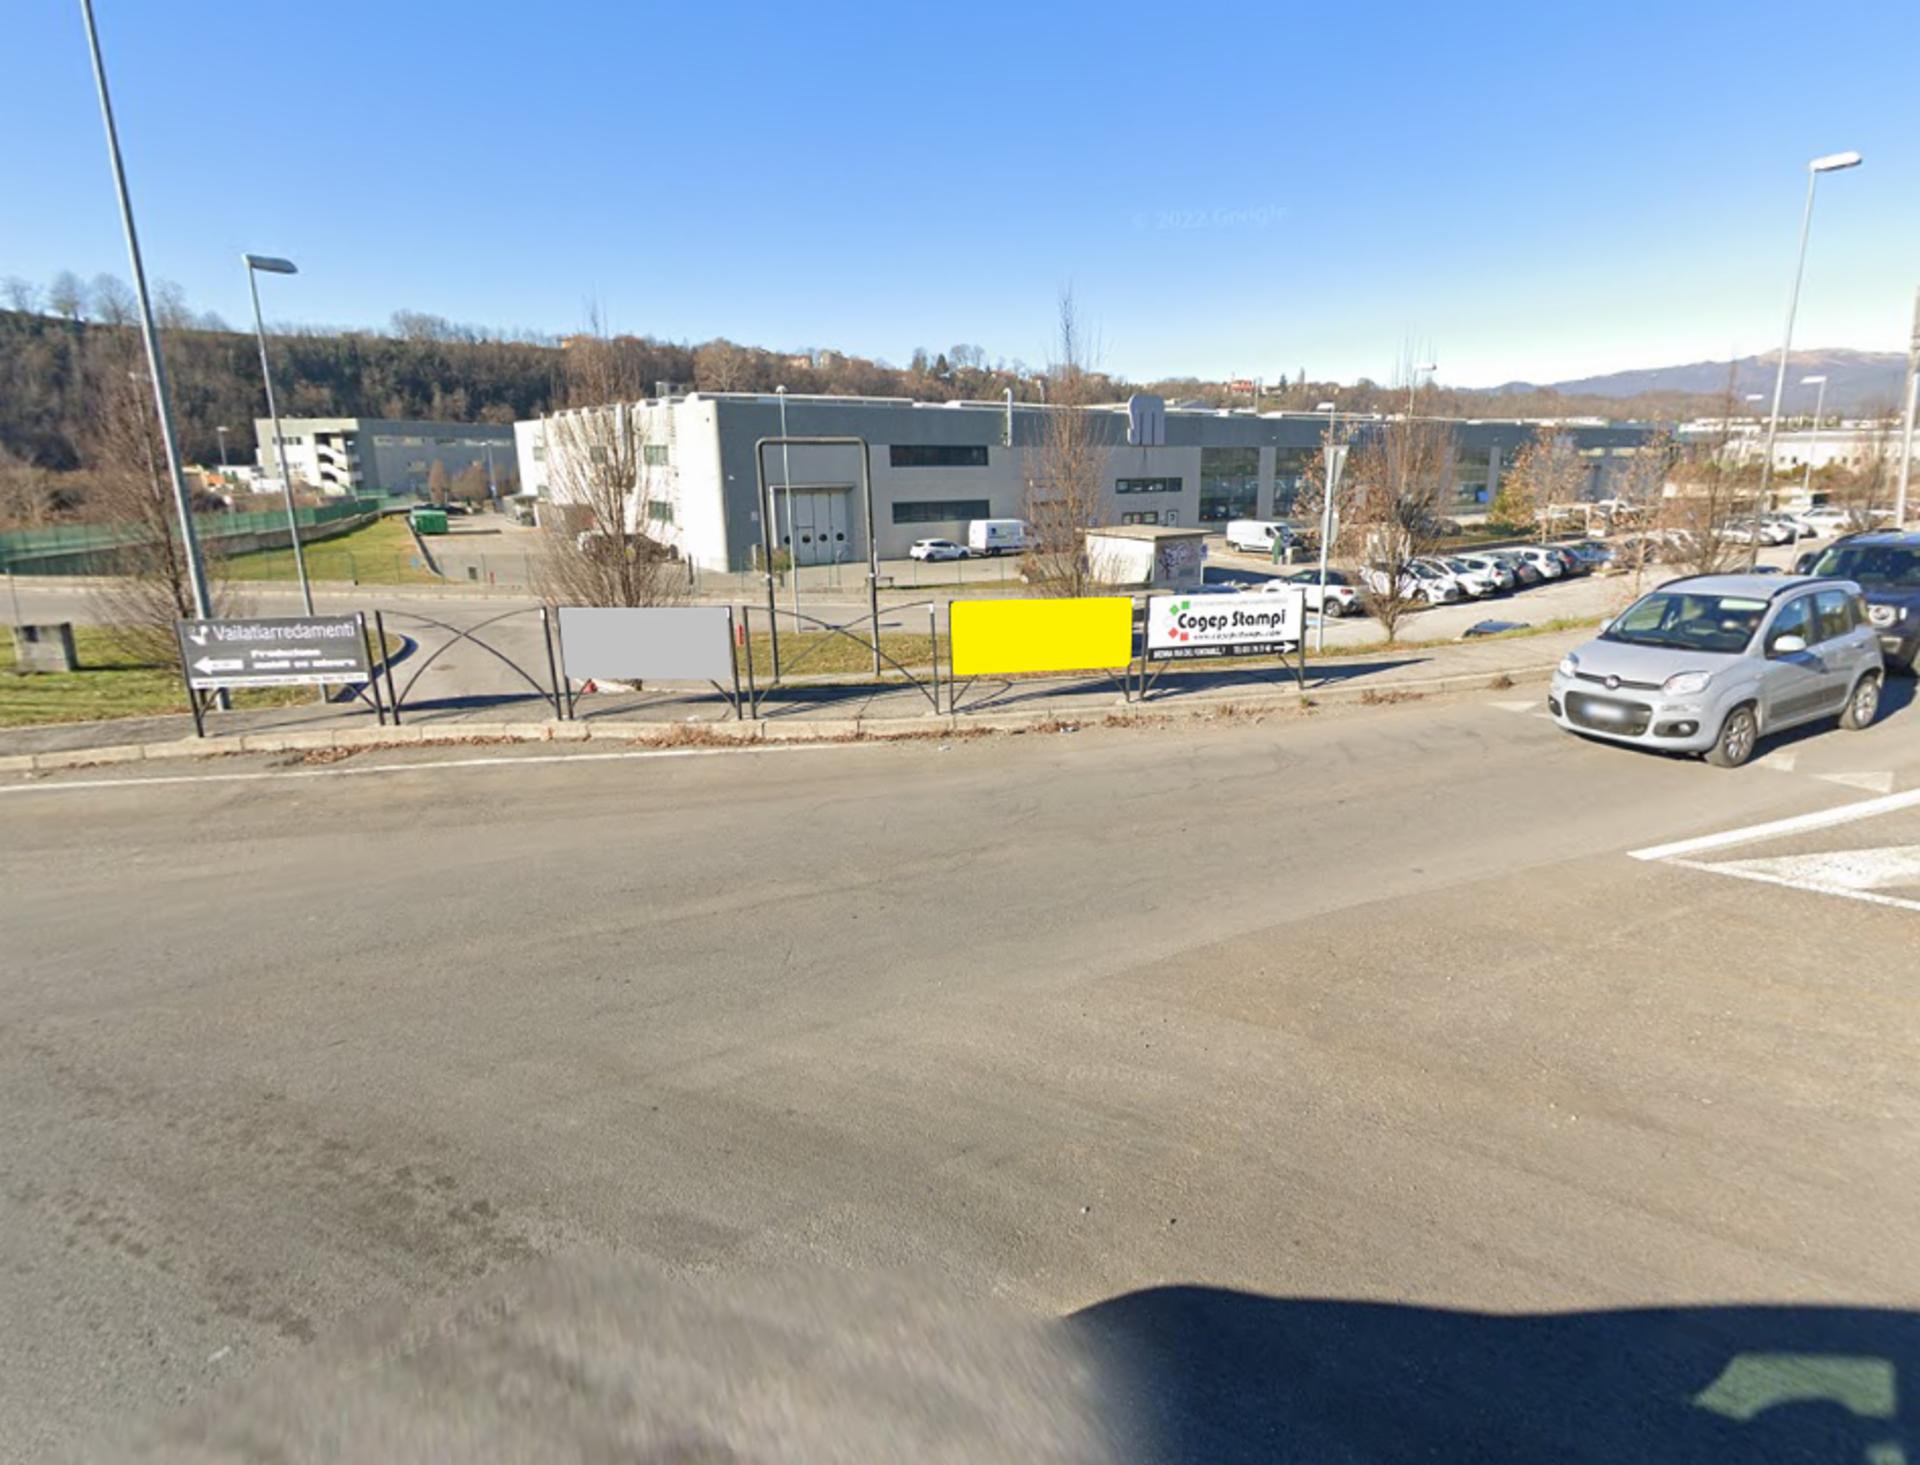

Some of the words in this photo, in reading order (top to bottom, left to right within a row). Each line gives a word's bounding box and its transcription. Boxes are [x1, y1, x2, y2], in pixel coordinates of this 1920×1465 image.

[212, 621, 355, 641] Vailatiarredamenti
[1178, 613, 1228, 632] Cogep
[1231, 608, 1286, 628] Stampi
